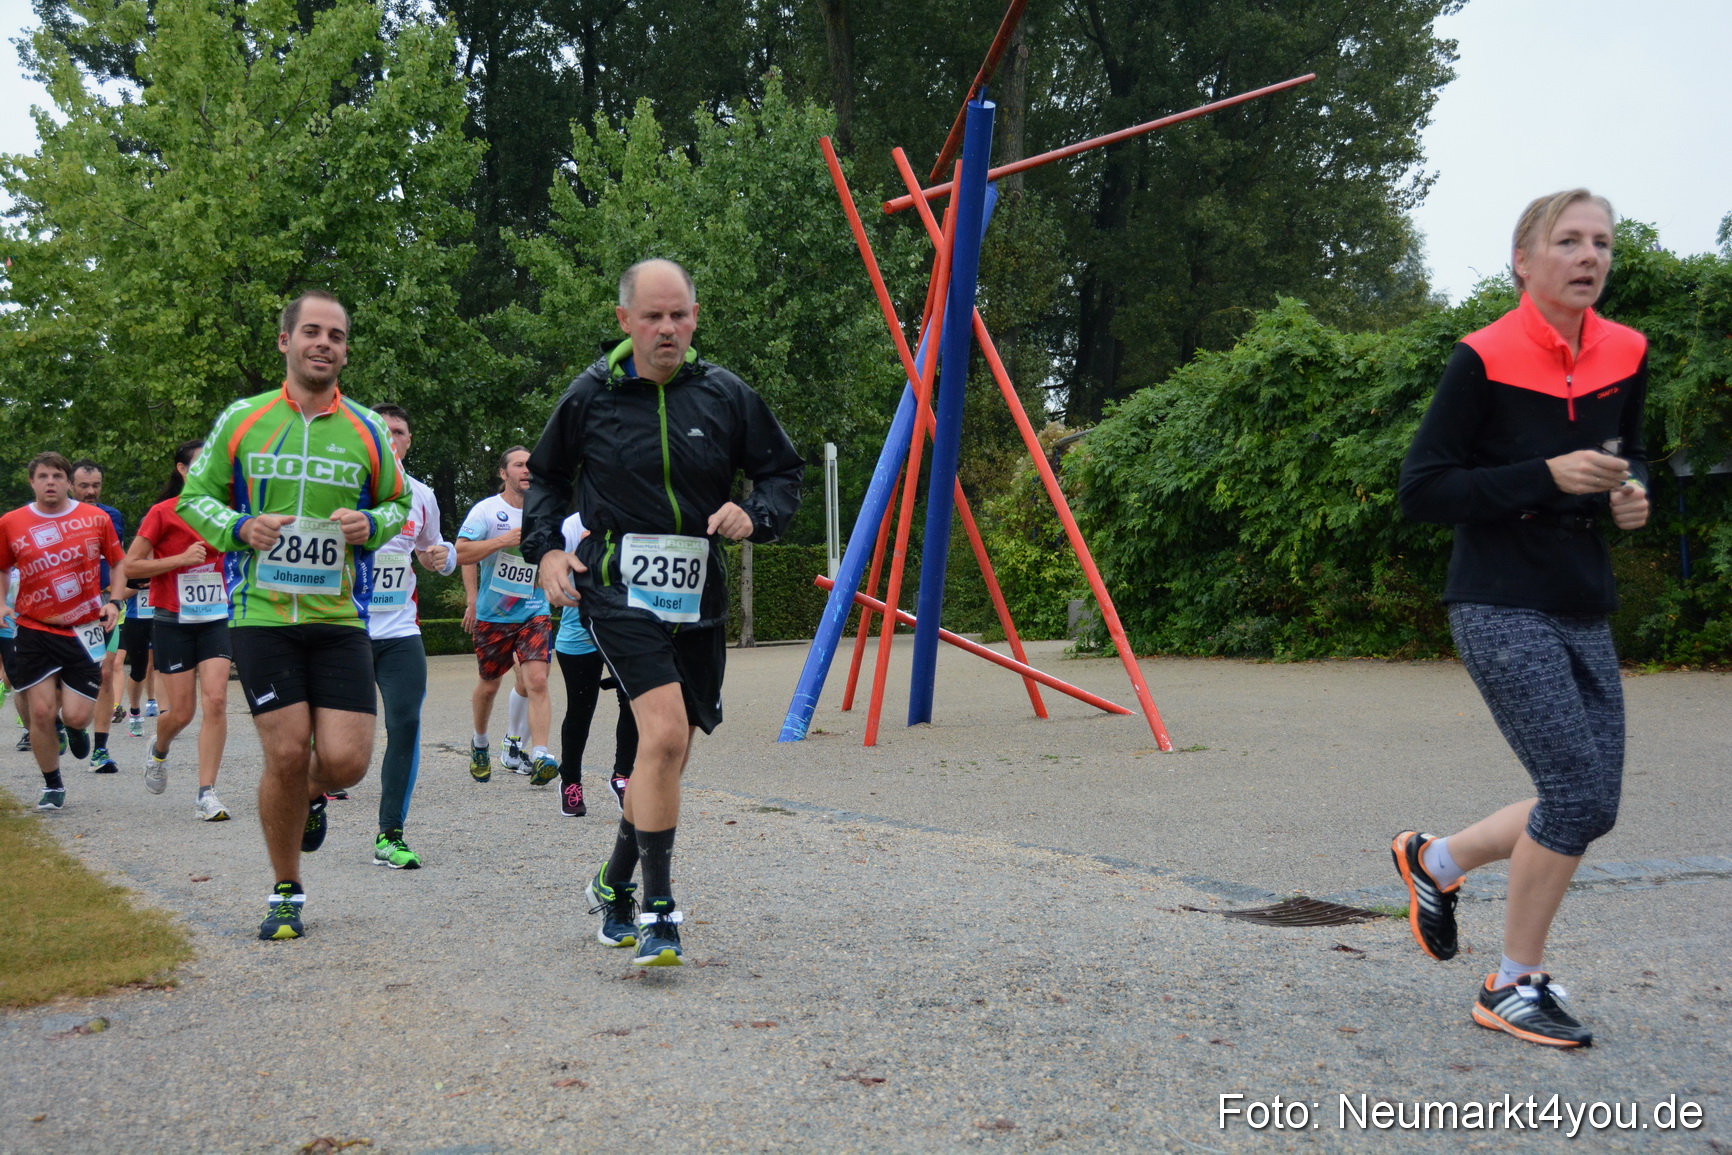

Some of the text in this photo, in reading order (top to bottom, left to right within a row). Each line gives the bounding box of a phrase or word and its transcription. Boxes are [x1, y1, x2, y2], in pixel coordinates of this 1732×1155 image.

[249, 453, 362, 488] BOCK
[268, 534, 338, 567] 2846
[273, 569, 326, 585] Johannes
[498, 563, 534, 583] 3059
[631, 555, 701, 589] 2358
[185, 585, 222, 602] 3077
[652, 595, 683, 609] Josef
